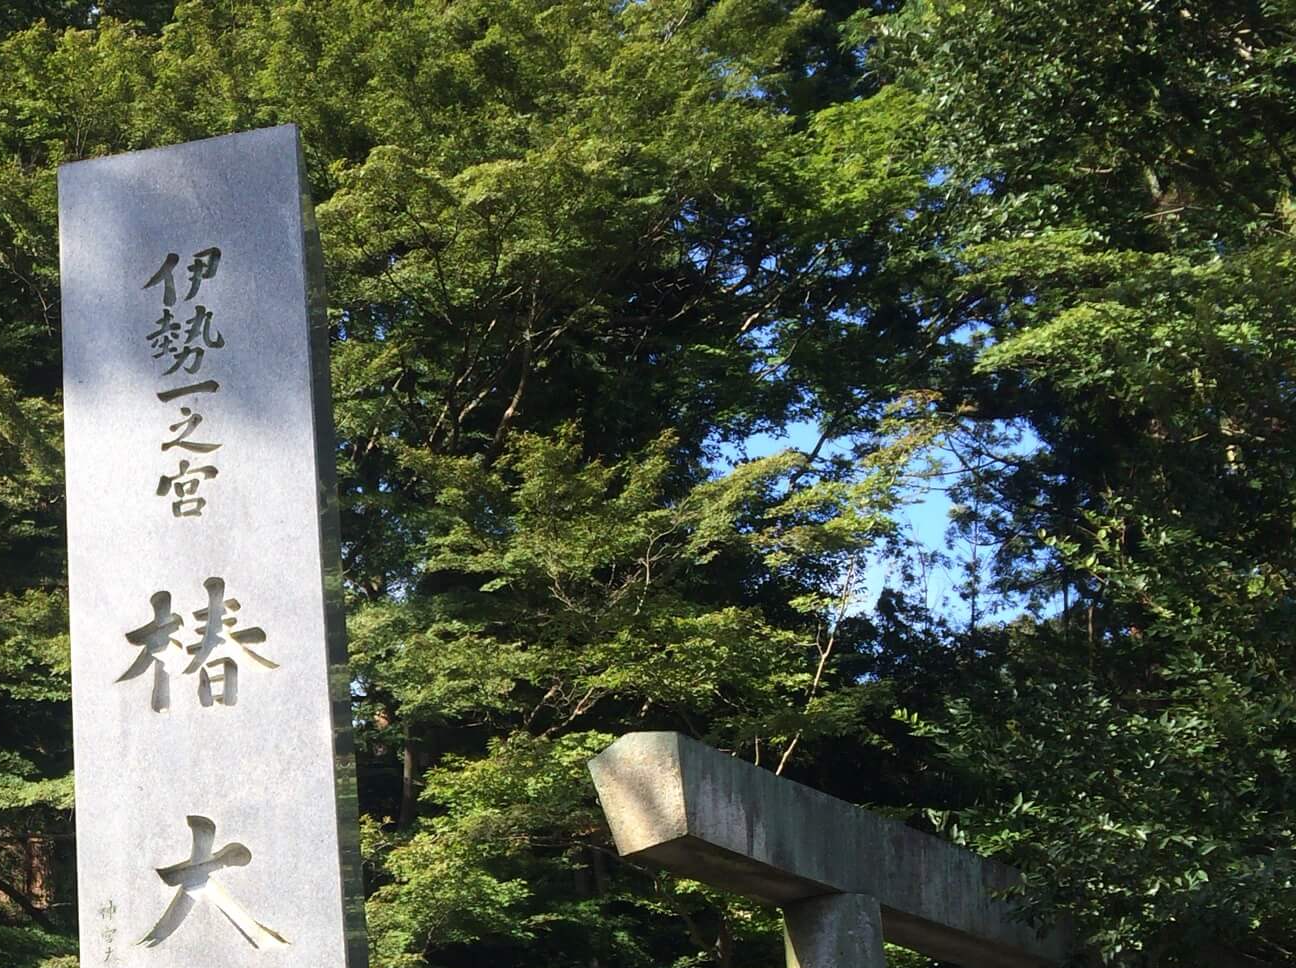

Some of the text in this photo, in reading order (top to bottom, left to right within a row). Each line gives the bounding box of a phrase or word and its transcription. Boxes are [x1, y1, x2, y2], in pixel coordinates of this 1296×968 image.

[143, 246, 225, 518] 伊勢一之宮
